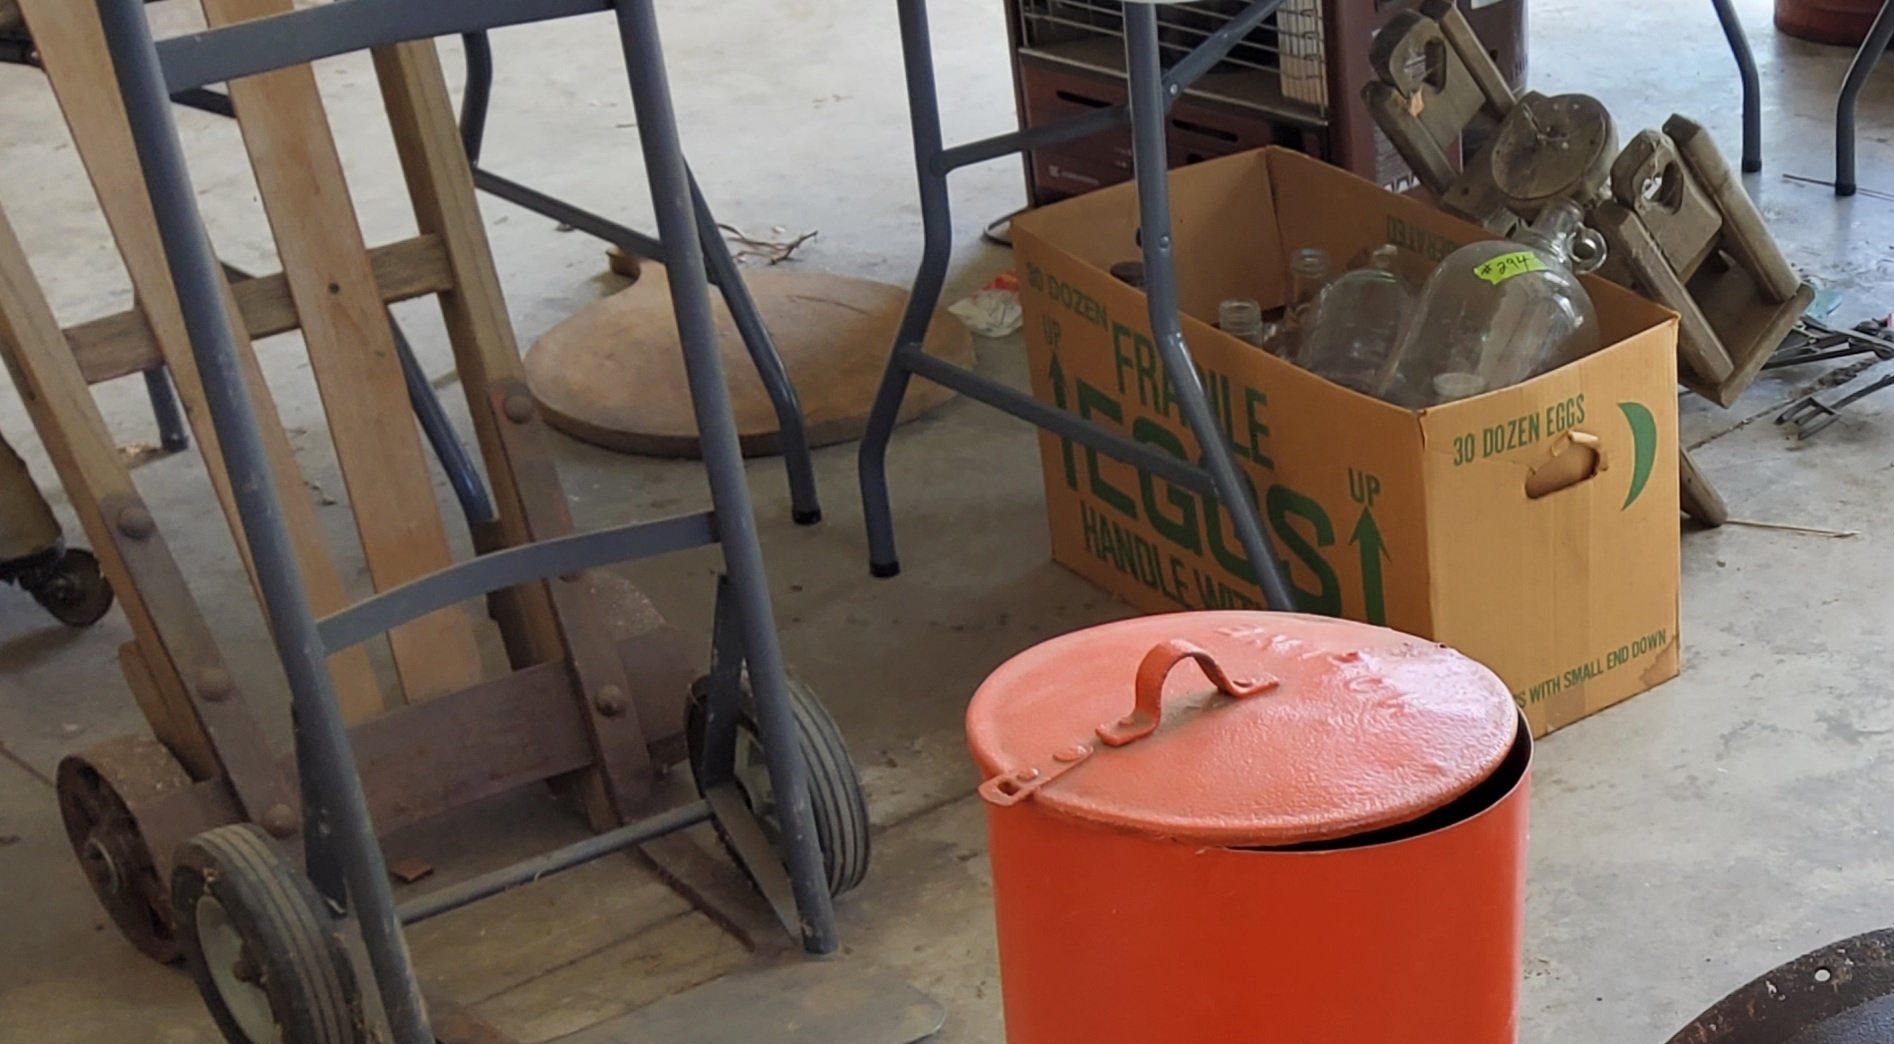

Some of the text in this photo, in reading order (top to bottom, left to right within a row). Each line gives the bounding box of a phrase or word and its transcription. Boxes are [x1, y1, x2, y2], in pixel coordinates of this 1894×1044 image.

[1047, 273, 1109, 332] DOZEN
[1111, 320, 1275, 470] FRAILE
[1454, 393, 1586, 467] 30 DOZEN EGGS
[1347, 467, 1381, 507] UP
[1080, 501, 1192, 609] HANDLE
[1529, 677, 1561, 704] WITH
[1564, 658, 1604, 689] SMALL
[1606, 645, 1630, 671] END
[1632, 628, 1667, 659] DOWN
